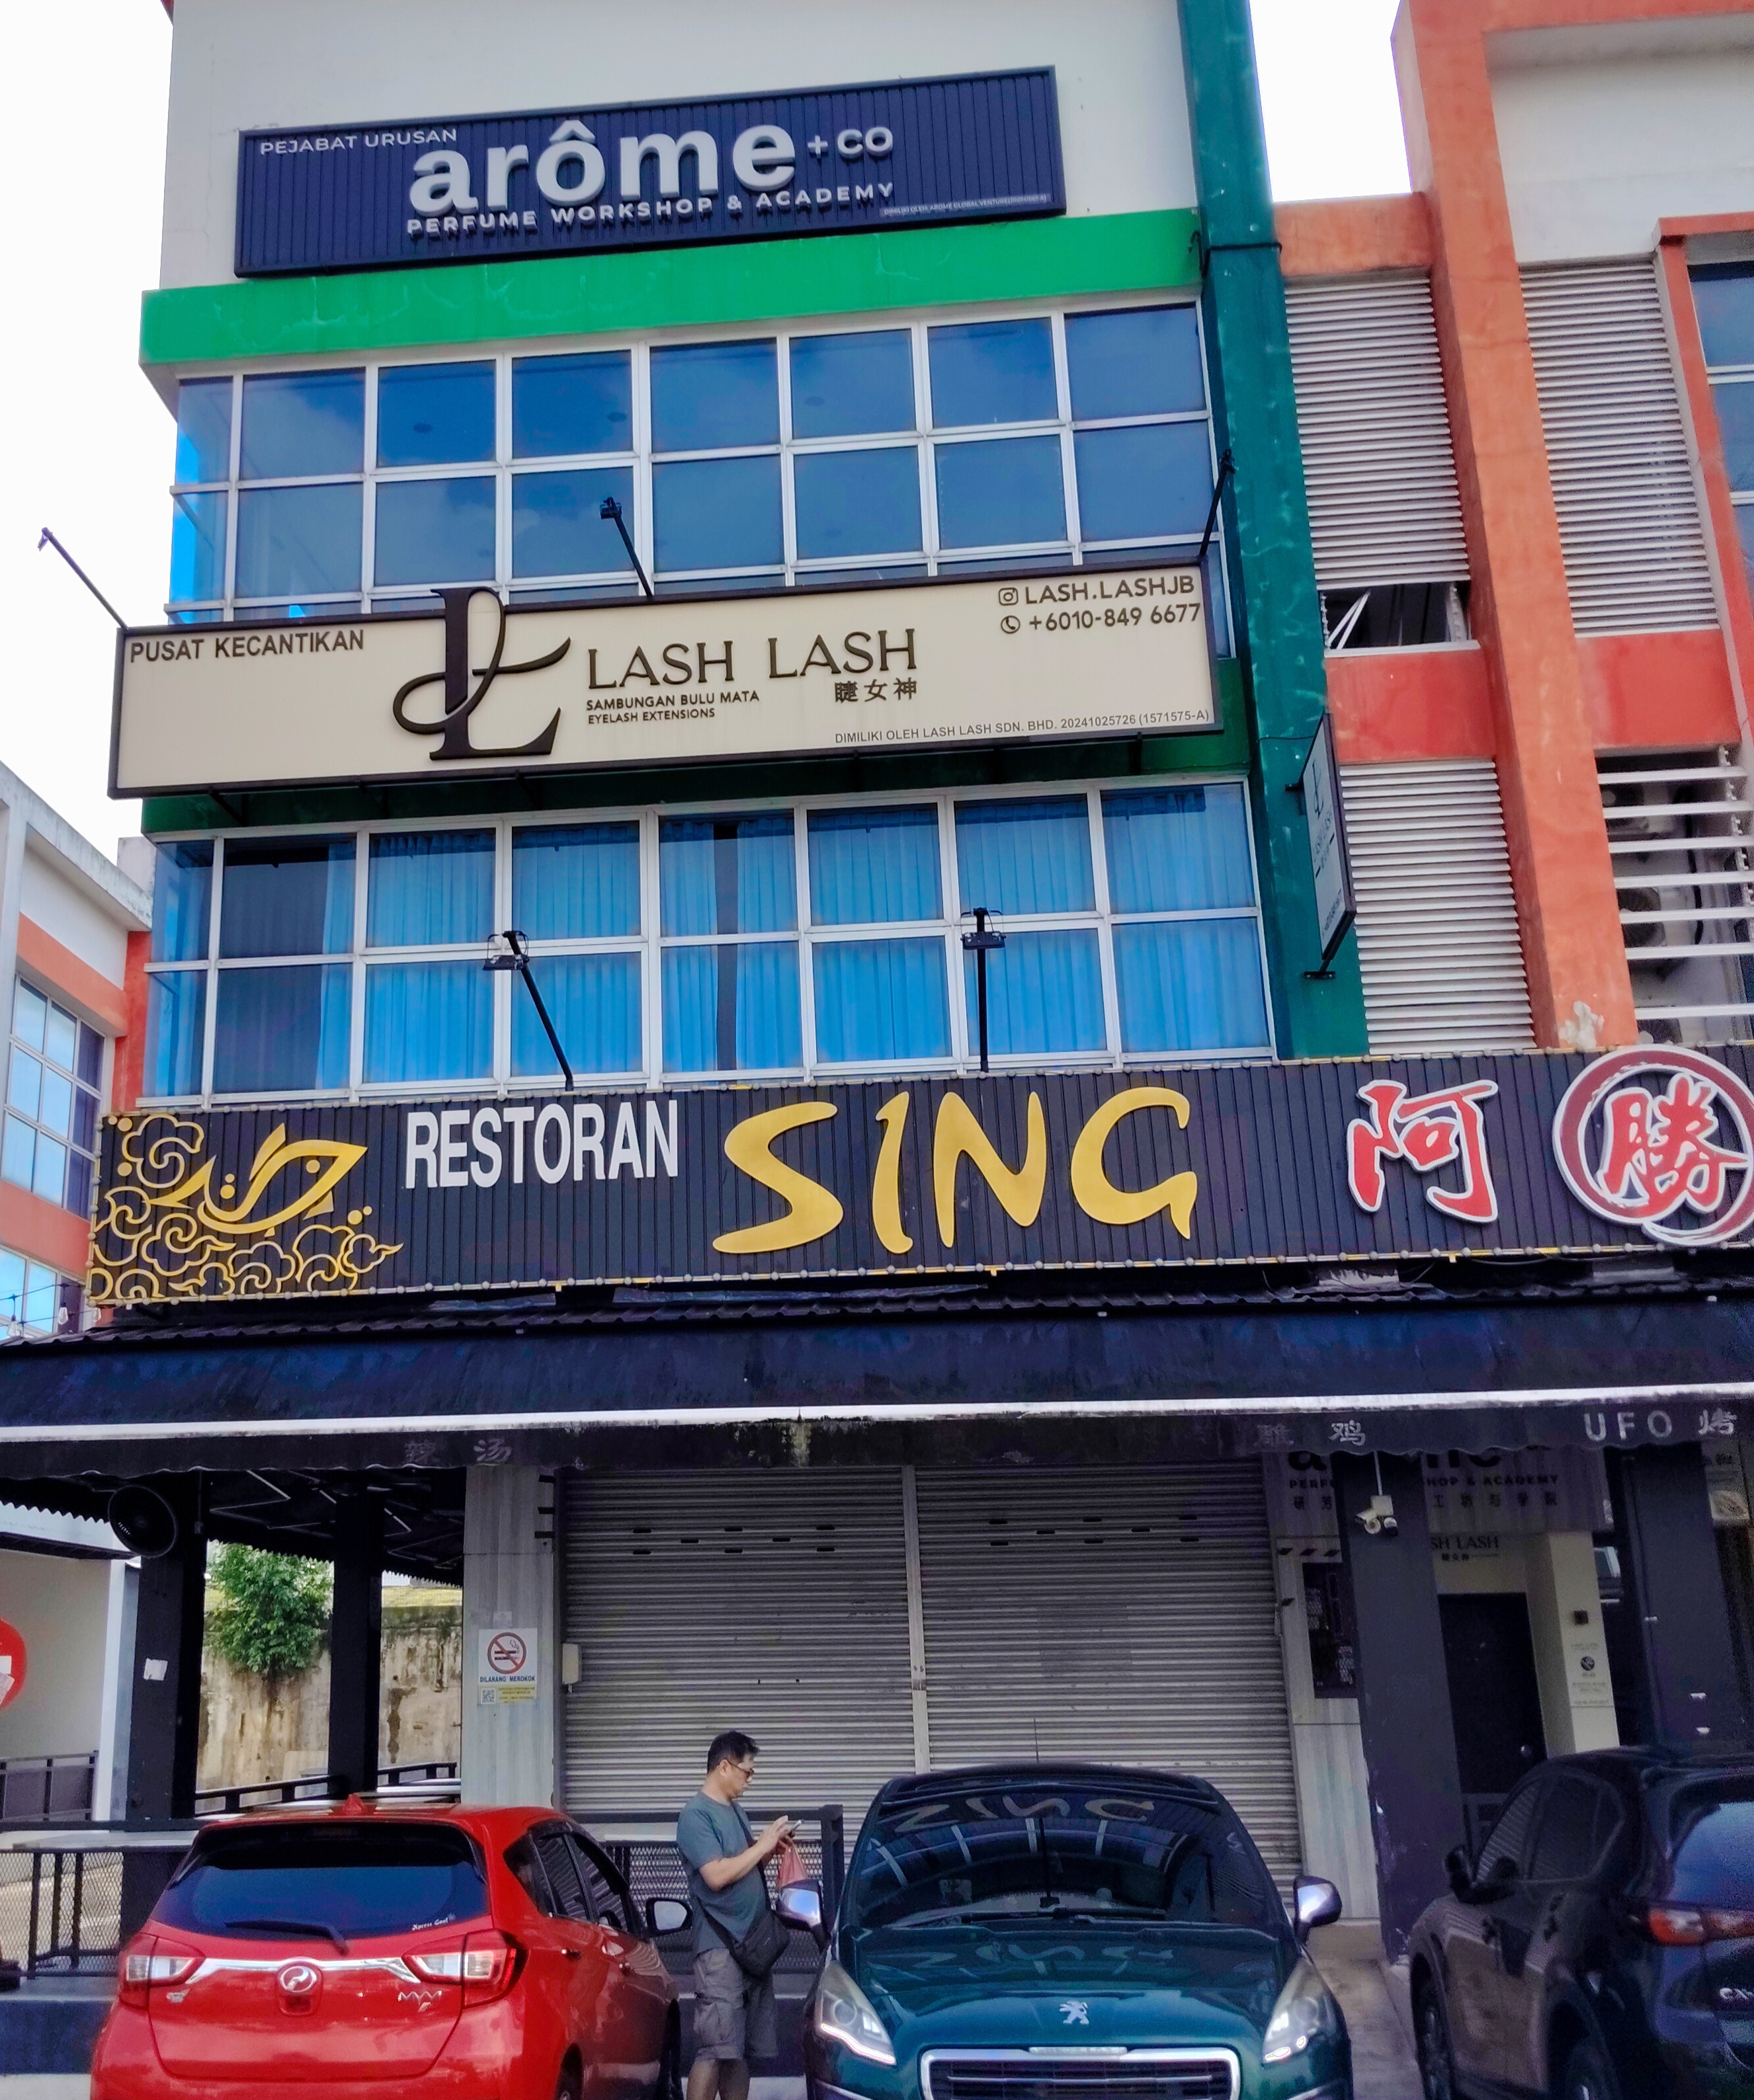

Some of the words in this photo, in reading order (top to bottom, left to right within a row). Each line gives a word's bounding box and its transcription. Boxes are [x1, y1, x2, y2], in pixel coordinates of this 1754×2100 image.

[260, 135, 358, 155] PEJABAT
[364, 129, 457, 149] URUSAN
[409, 120, 795, 217] arôme
[407, 210, 537, 235] PERFUME
[551, 198, 712, 225] WORKSHOP
[727, 195, 742, 210] &
[756, 183, 894, 210] ACADEMY
[1025, 575, 1194, 604] LASH.LASHJB
[1028, 607, 1142, 631] +6010-849
[1150, 602, 1200, 625] 6677
[130, 638, 204, 663] PUSAT
[214, 628, 364, 659] KECANTIKAN
[587, 640, 735, 690] LASH
[768, 627, 917, 680] LASH
[586, 694, 676, 711] SAMBUNGAN
[680, 692, 715, 706] BULU
[720, 690, 760, 704] MATA
[834, 677, 917, 704] 睫女神
[588, 711, 638, 725] EYELASH
[642, 707, 716, 722] EXTENSIONS
[835, 731, 882, 744] DIMILIKI
[886, 728, 921, 741] OLEH
[923, 726, 956, 739] LASH
[958, 724, 992, 736] LASH
[995, 721, 1024, 734] SDN.
[1028, 719, 1058, 731] BHD.
[1060, 714, 1136, 729] 20241025726
[1138, 709, 1209, 725] (1571575-A)
[405, 1099, 678, 1190] RESTORAN
[712, 1086, 1198, 1254] SING
[1583, 1409, 1673, 1441] UFO
